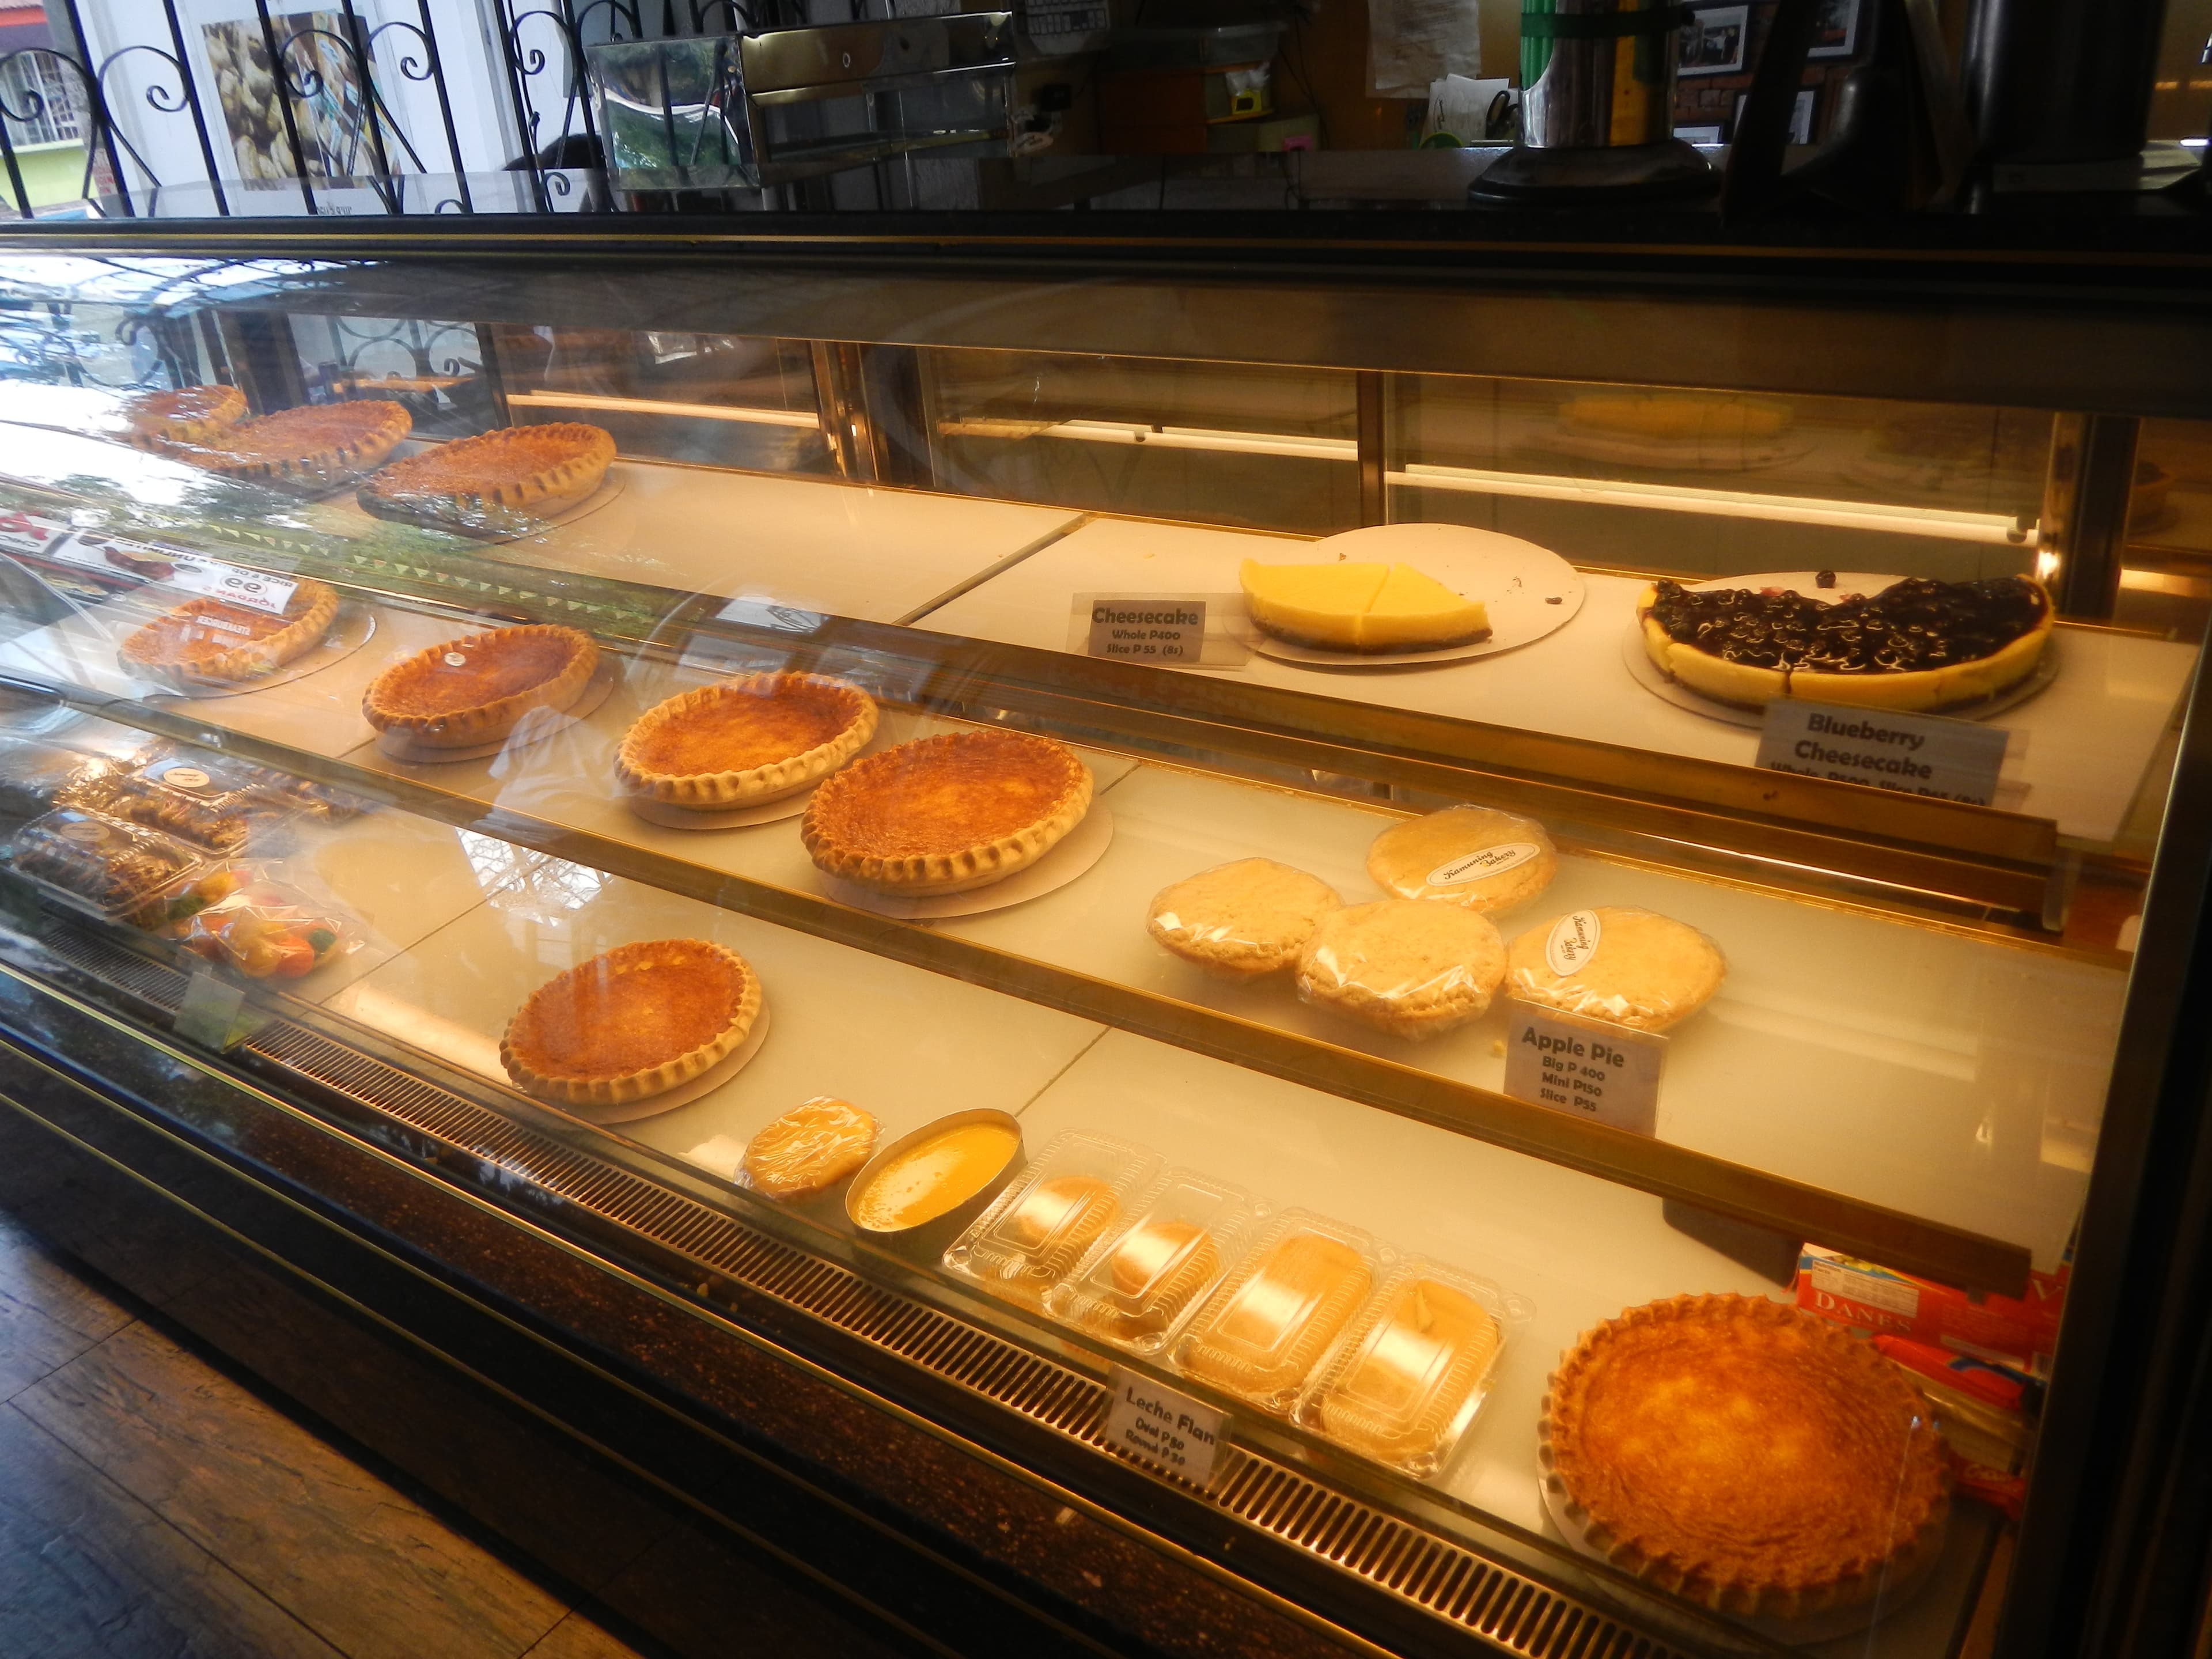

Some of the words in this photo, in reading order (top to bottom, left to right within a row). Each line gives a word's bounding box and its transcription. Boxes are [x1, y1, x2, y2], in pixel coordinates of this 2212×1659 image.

[1092, 607, 1199, 625] Cheesecake
[1112, 629, 1146, 640] Whole
[1149, 630, 1180, 640] P400
[1106, 643, 1130, 654] Slice
[1162, 645, 1184, 656] (8s)
[1806, 712, 1925, 751] Blueberry
[1794, 739, 1933, 780] Cheesecake
[1443, 851, 1494, 880] Kamuning
[1479, 849, 1516, 868] Bakery
[1521, 1026, 1585, 1057] Apple
[1590, 1041, 1625, 1068] Pie
[1542, 1055, 1564, 1072] Big
[1580, 1066, 1605, 1081] 400
[1541, 1071, 1570, 1088] Mini
[1573, 1079, 1603, 1097] P150
[1540, 1088, 1567, 1104] Slice
[1573, 1096, 1597, 1112] P55
[1126, 1387, 1173, 1425] Leche
[1176, 1413, 1214, 1446] Flan
[1135, 1416, 1160, 1438] Oval
